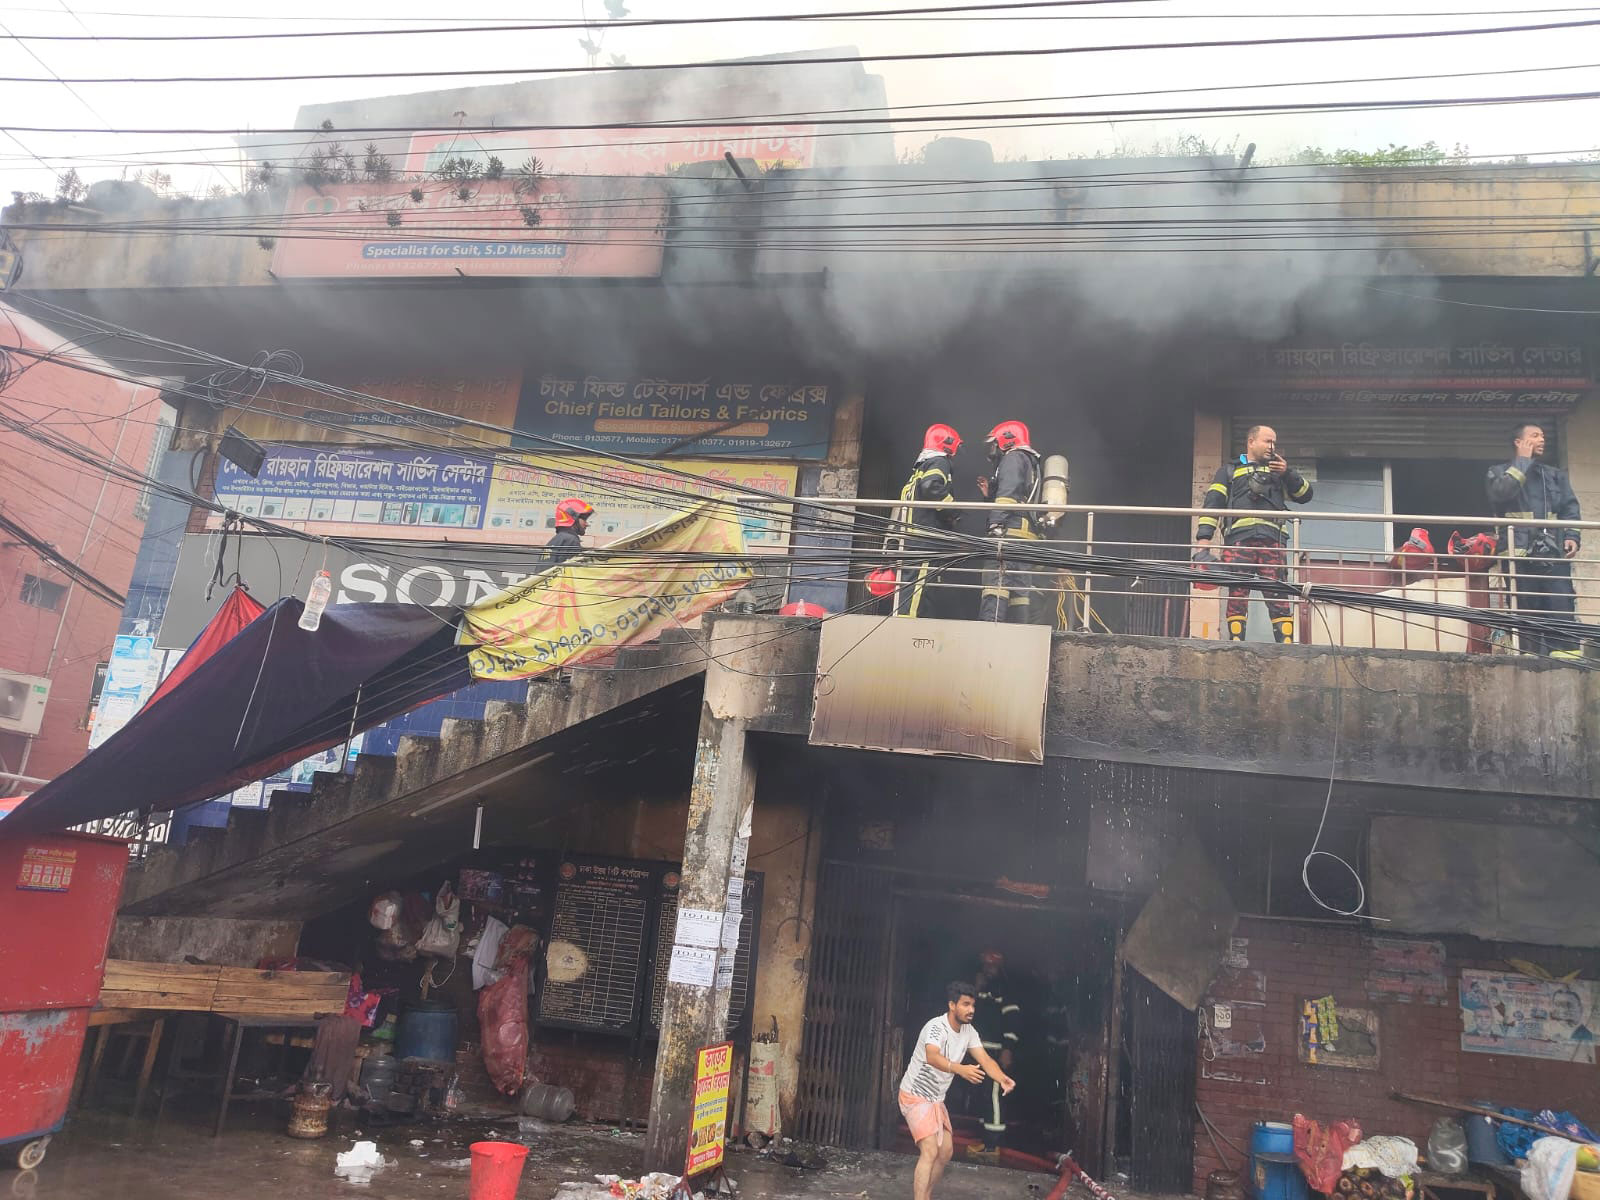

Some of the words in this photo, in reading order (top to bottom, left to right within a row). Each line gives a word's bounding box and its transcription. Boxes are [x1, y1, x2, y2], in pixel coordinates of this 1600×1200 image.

[366, 245, 428, 258] Specialist
[430, 245, 450, 256] for
[452, 245, 481, 257] Suit,
[484, 245, 507, 256] S.D
[509, 245, 563, 256] Messkit
[1457, 341, 1514, 366] সার্ভিস
[1521, 344, 1583, 367] সেন্টার
[632, 376, 711, 402] টেইলার্স
[716, 382, 753, 401] এন্ড
[1455, 390, 1513, 404] সার্ভিস
[1517, 390, 1581, 404] সেন্টার
[544, 399, 594, 417] Chief
[598, 402, 643, 418] Field
[649, 404, 711, 420] Tailors
[716, 405, 730, 421] &
[552, 433, 583, 443] Phone:
[584, 434, 624, 445] 9132677,
[626, 436, 660, 445] Mobile:
[266, 456, 312, 480] রায়হান
[314, 453, 394, 481] রিফ্রিজারেশন
[397, 457, 440, 483] সার্ভিস
[442, 458, 488, 484] সেন্টার
[336, 562, 528, 608] SON
